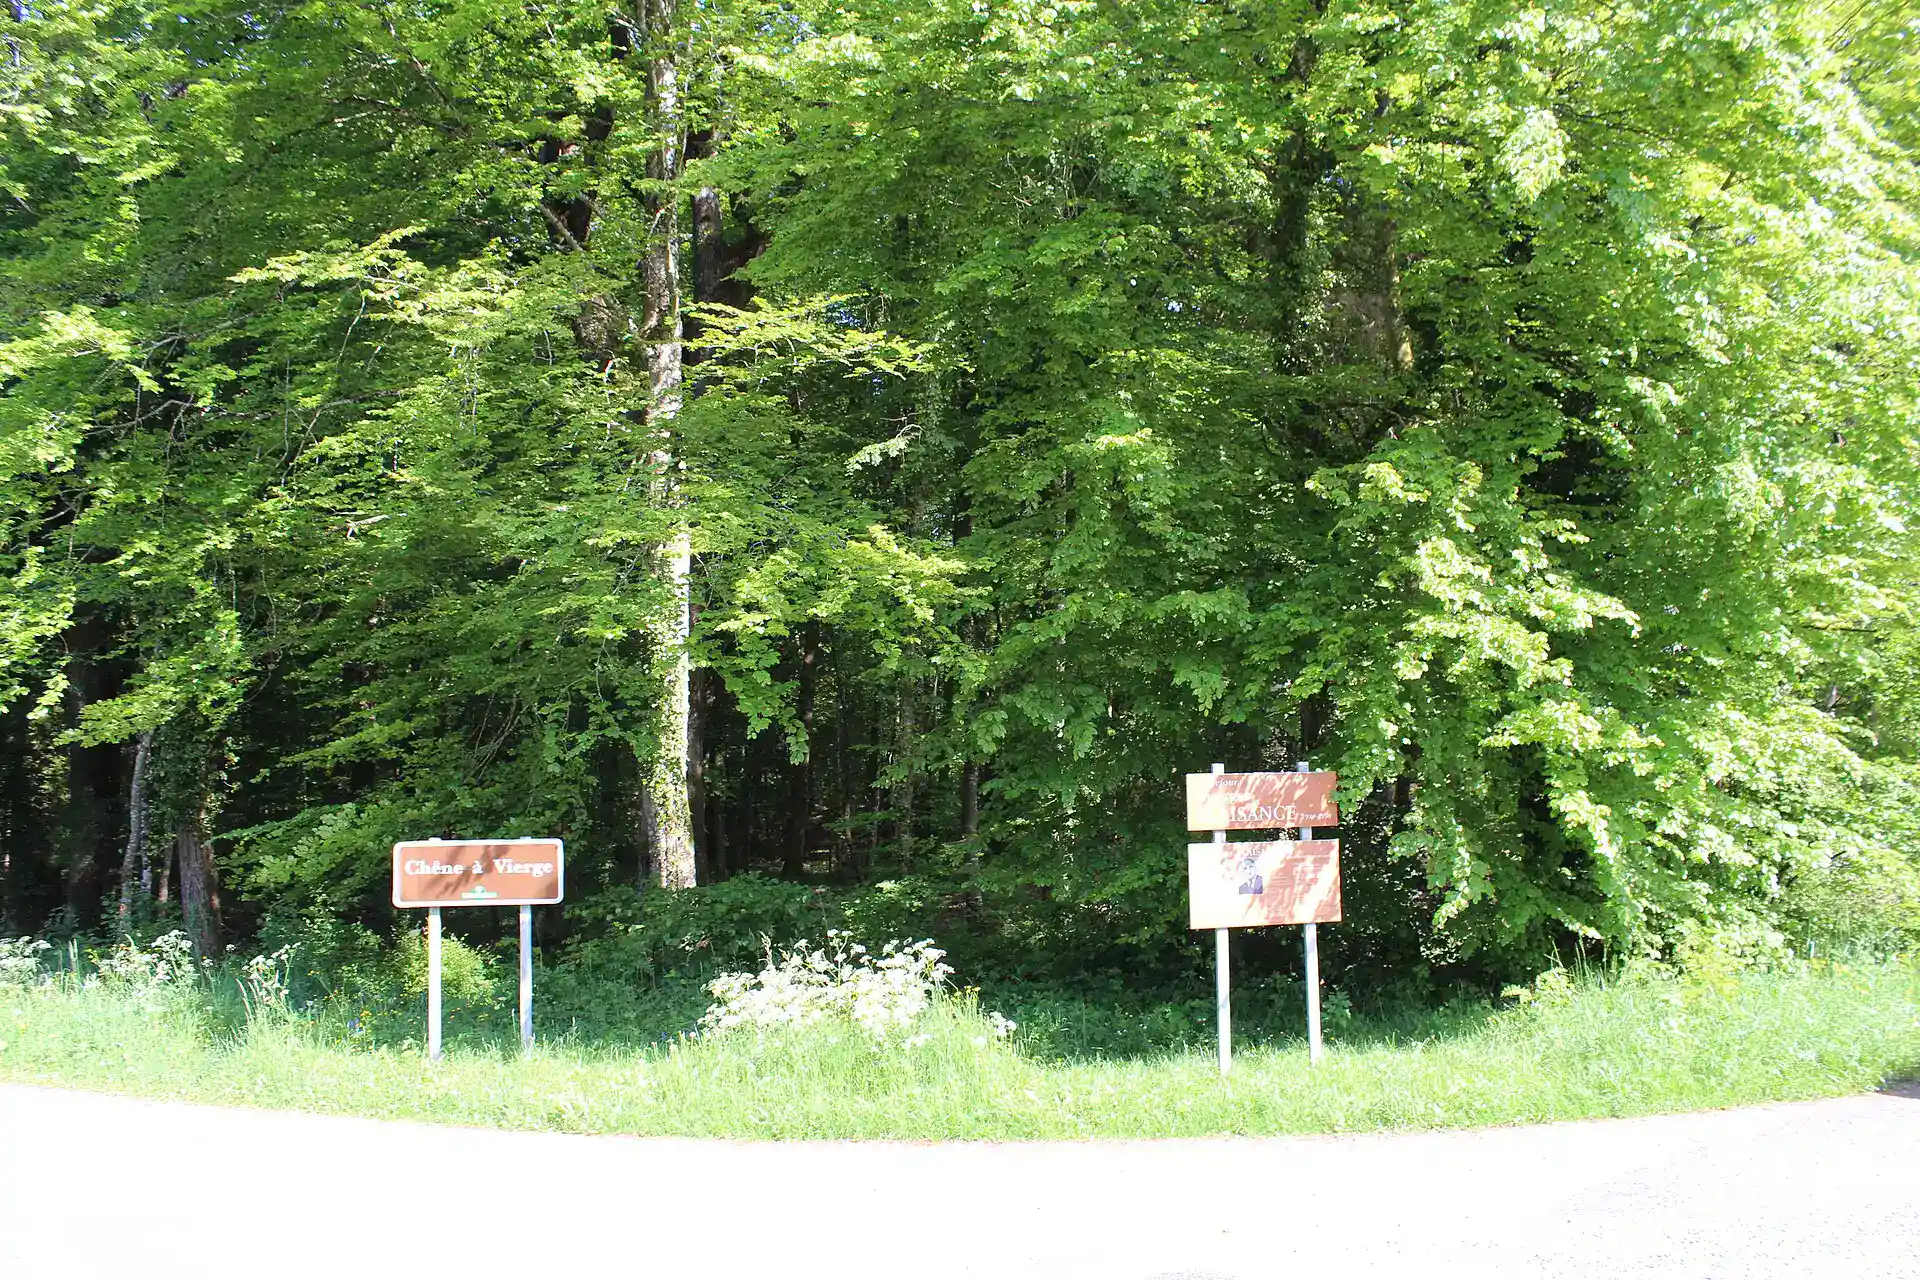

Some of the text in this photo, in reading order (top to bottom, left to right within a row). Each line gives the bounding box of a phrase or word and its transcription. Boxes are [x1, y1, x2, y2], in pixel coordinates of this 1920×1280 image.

[1230, 805, 1297, 822] ISANCE
[404, 858, 554, 877] Chêne à Vierge
